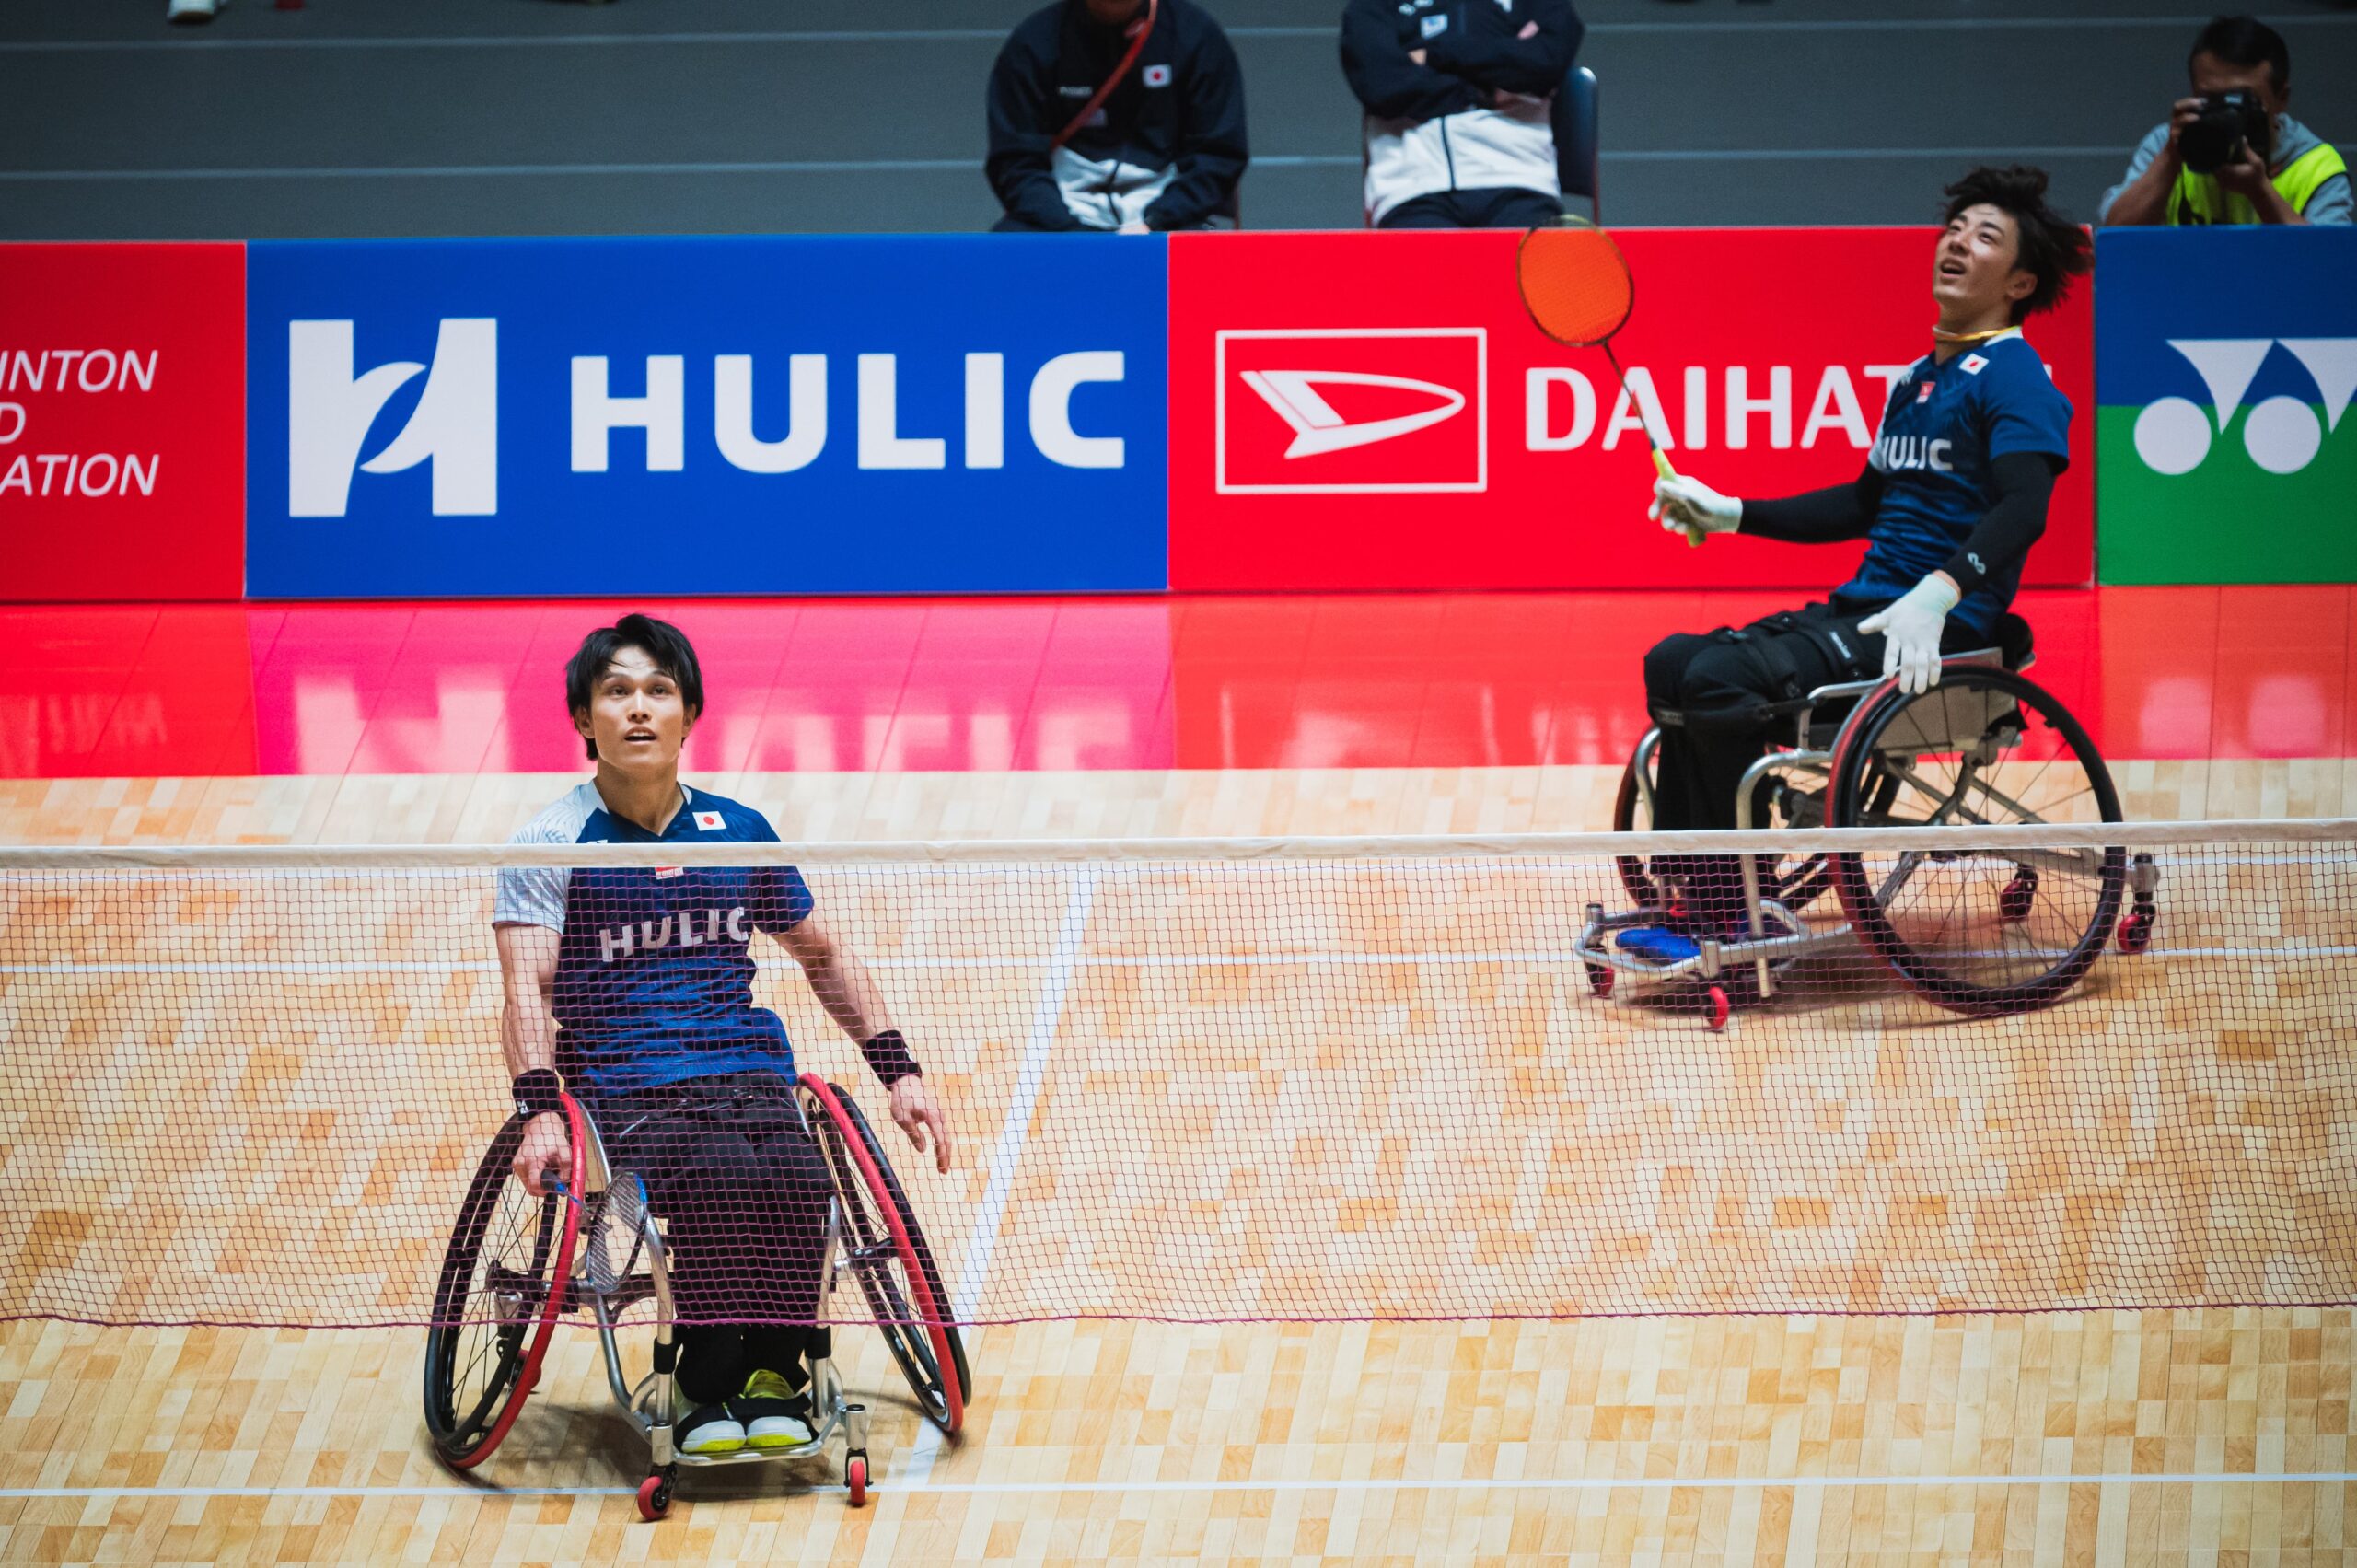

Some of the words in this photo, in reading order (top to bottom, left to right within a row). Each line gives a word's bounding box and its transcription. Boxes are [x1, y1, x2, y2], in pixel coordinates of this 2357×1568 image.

[571, 351, 1125, 473] HULIC
[0, 453, 159, 497] ATION
[599, 907, 749, 962] HULIC
